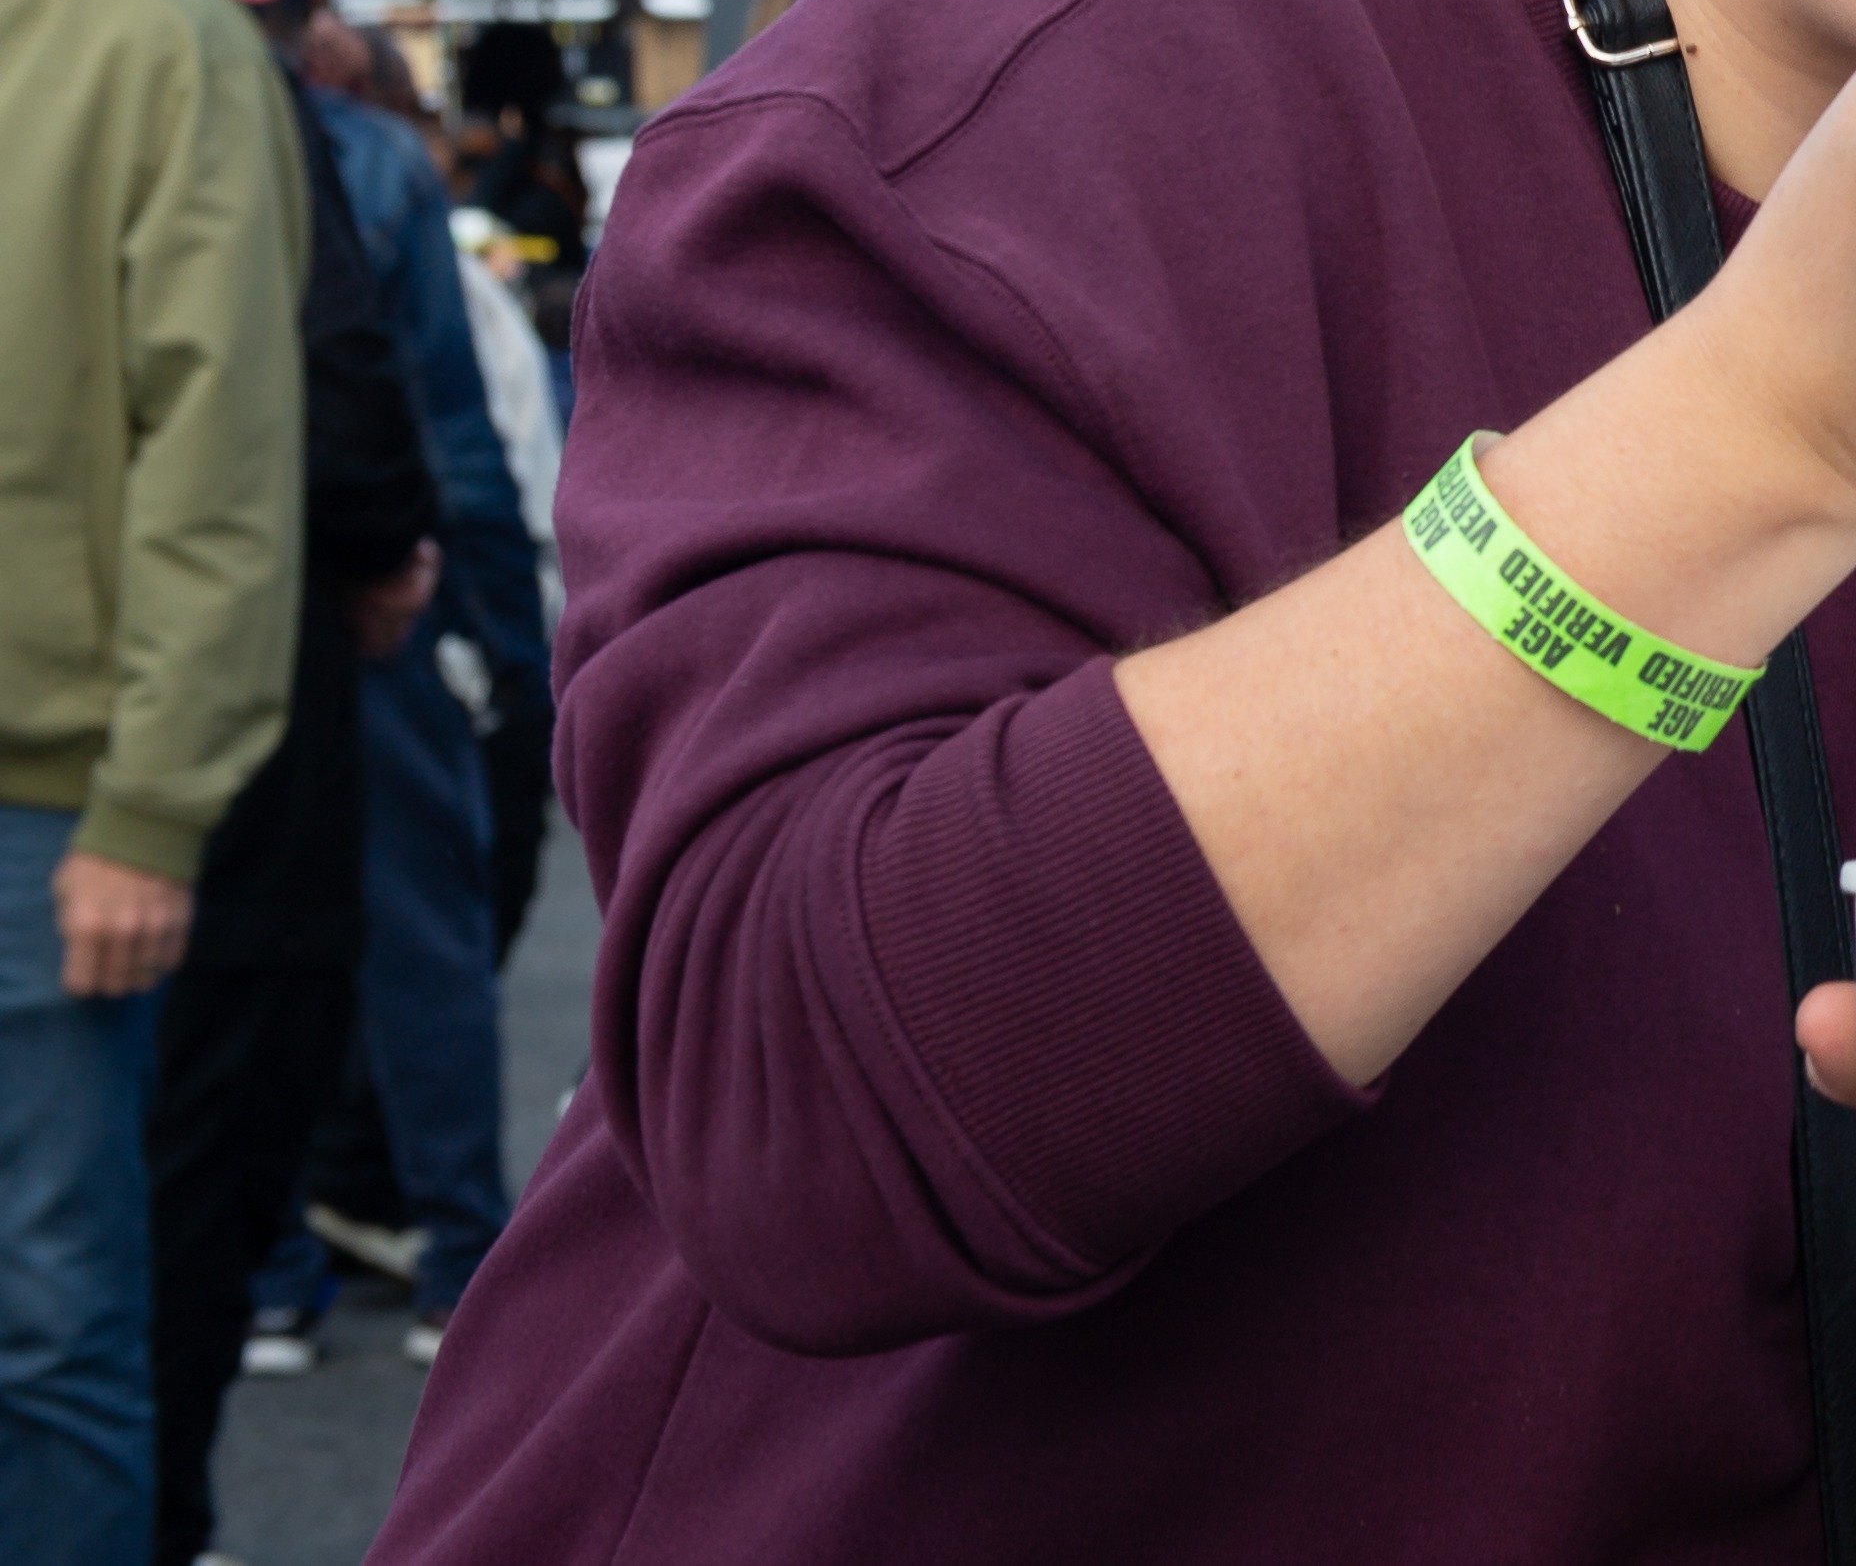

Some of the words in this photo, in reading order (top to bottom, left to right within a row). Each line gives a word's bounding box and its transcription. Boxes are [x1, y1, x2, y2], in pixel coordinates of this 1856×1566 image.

[1499, 547, 1633, 668] VERIFIED
[1504, 607, 1575, 670] AGE
[1646, 698, 1705, 742] AGE
